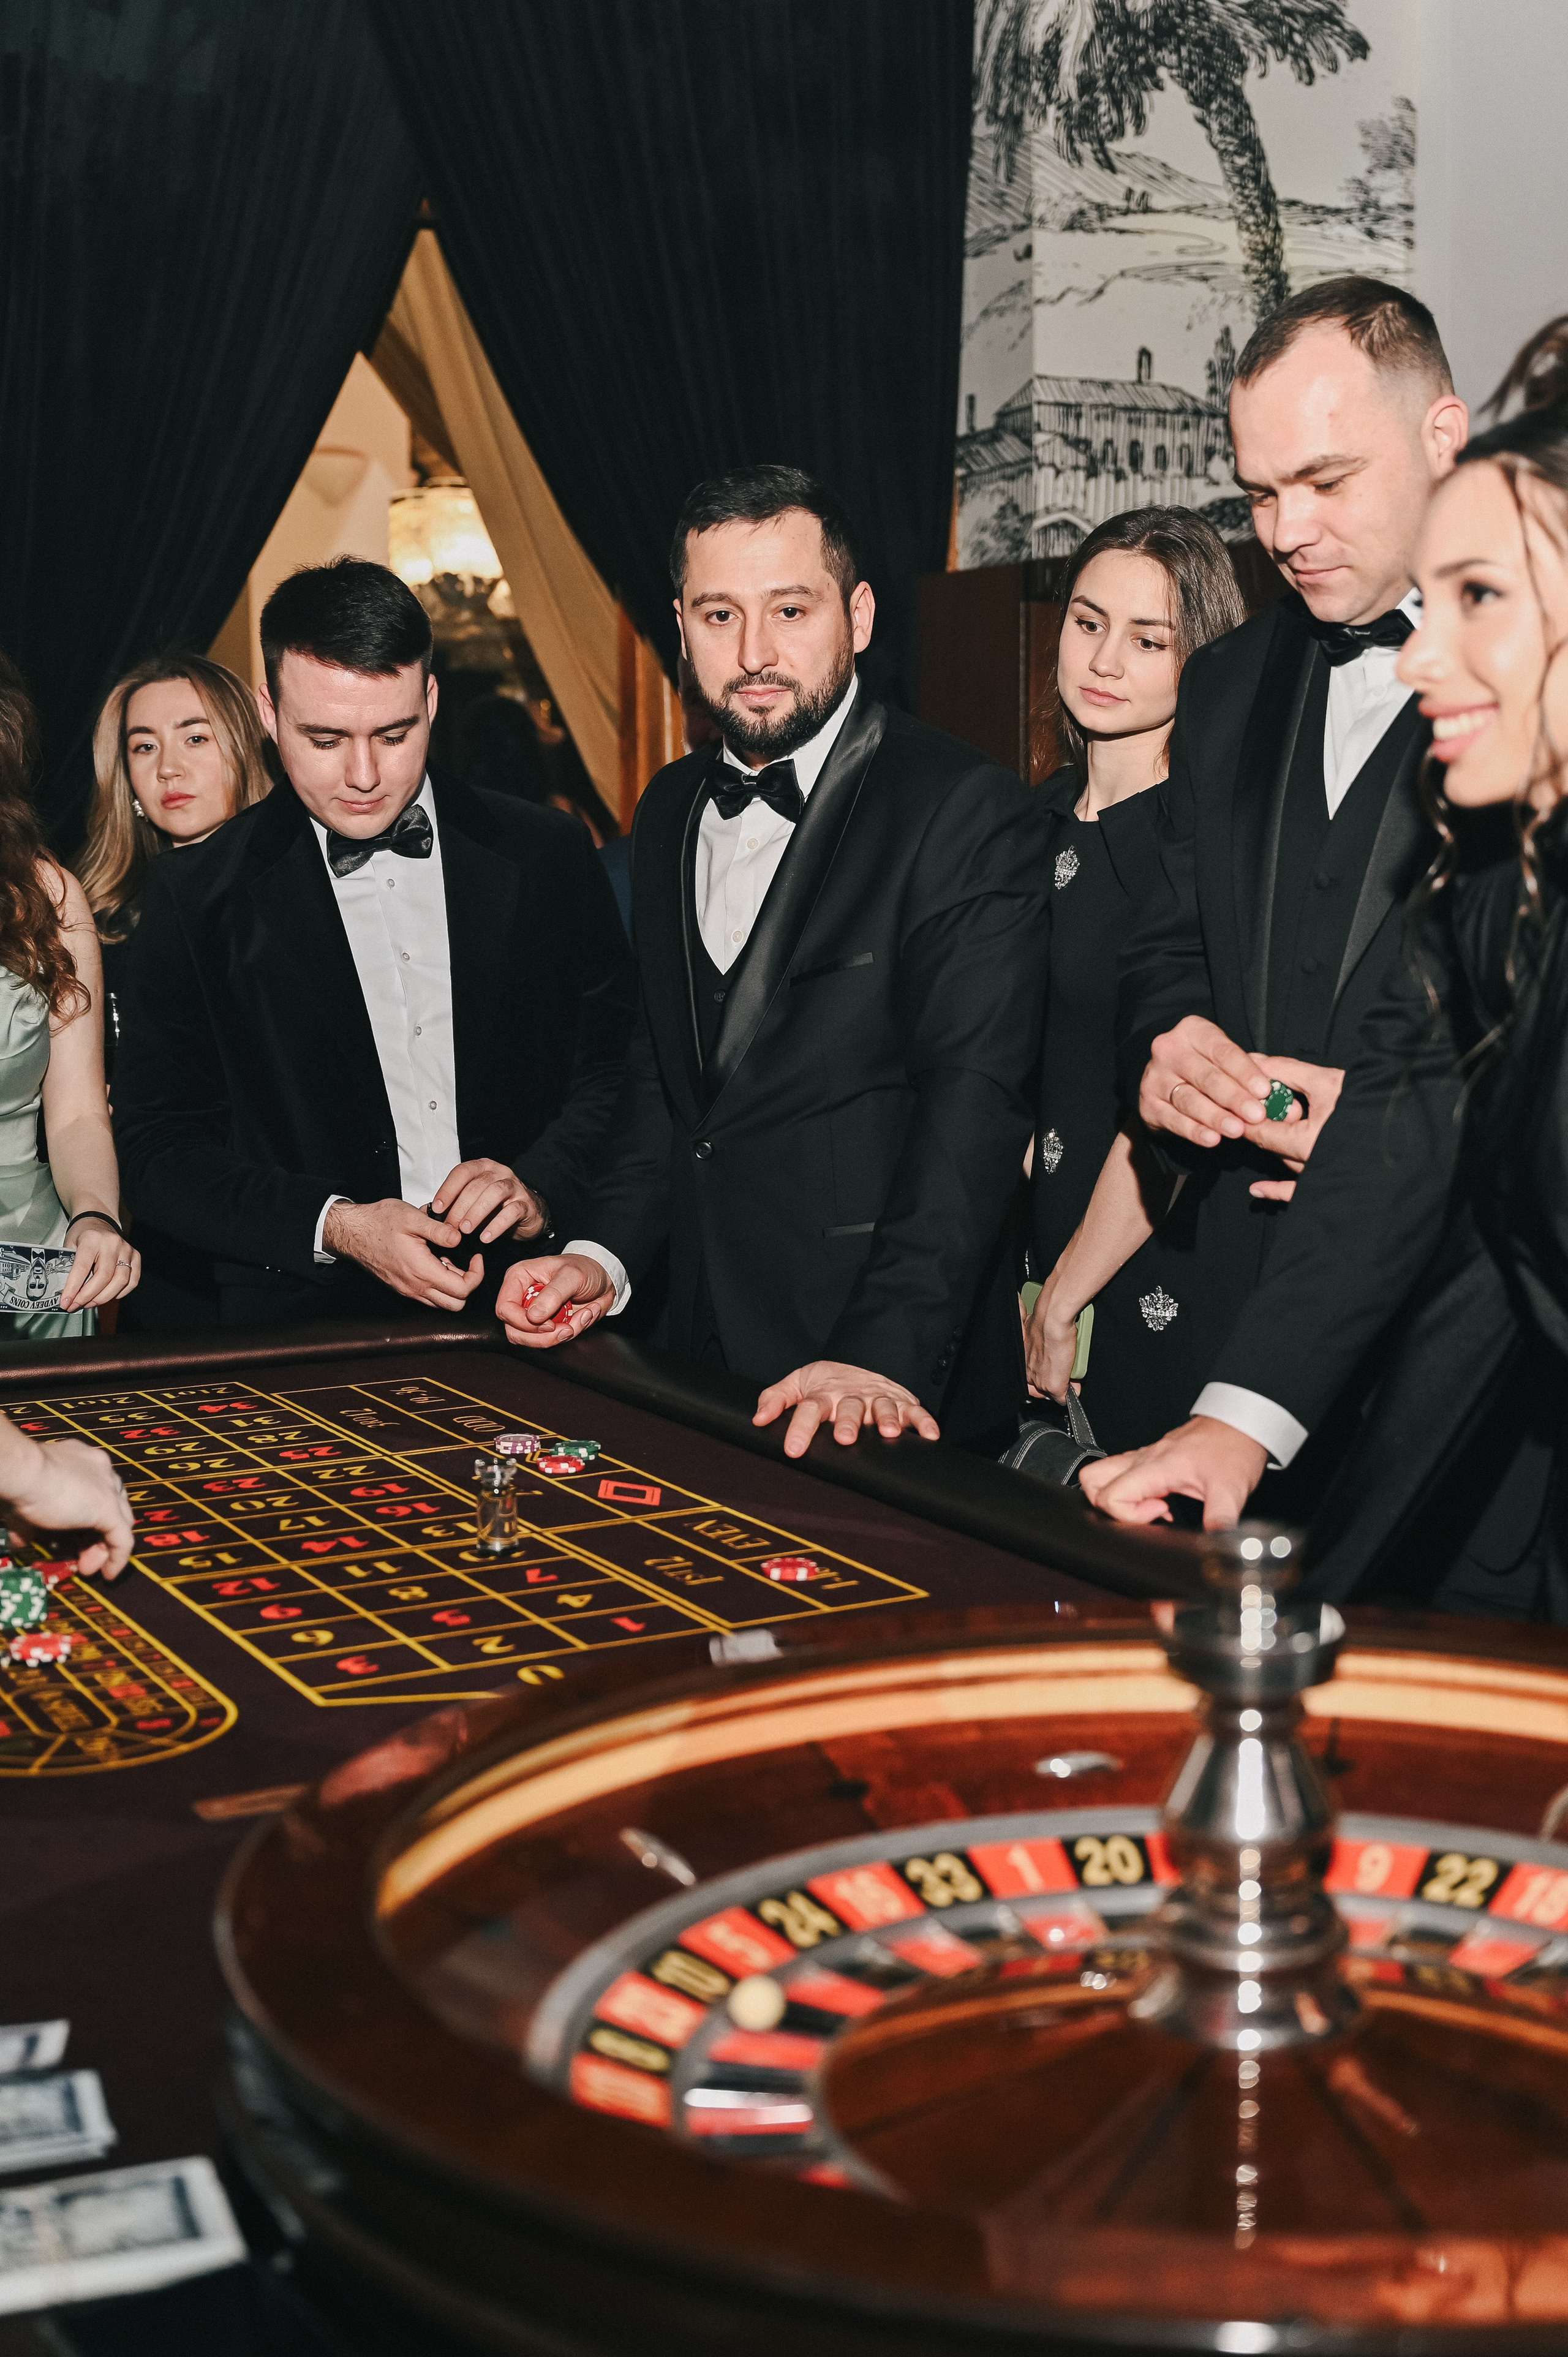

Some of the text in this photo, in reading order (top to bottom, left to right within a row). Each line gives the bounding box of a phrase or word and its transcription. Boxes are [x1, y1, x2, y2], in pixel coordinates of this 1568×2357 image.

[10, 1295, 59, 1309] AVDEEV COINS
[197, 1398, 258, 1412] 34
[99, 1412, 154, 1423] 35
[230, 1417, 279, 1427] 31
[453, 1416, 506, 1432] ODD
[119, 1426, 180, 1439] 32
[247, 1431, 307, 1444] 28
[144, 1442, 206, 1455] 29
[278, 1446, 341, 1460] 25
[168, 1458, 235, 1471] 26
[312, 1465, 375, 1479] 22
[203, 1476, 266, 1492] 23
[350, 1482, 410, 1497] 19
[230, 1495, 299, 1511] 20
[375, 1502, 440, 1517] 16
[279, 1515, 330, 1531] 17
[143, 1529, 209, 1547] 18
[684, 1519, 771, 1549] EVEN
[301, 1536, 369, 1553] 14
[178, 1552, 242, 1569] 15
[343, 1561, 402, 1578] 11
[525, 1567, 558, 1584] 7
[212, 1577, 281, 1596] 12
[388, 1586, 429, 1601] 8
[556, 1593, 593, 1608] 4
[259, 1604, 303, 1620] 9
[290, 1629, 334, 1646] 6
[472, 1635, 516, 1654] 2
[336, 1654, 379, 1675] 3
[1075, 1836, 1144, 1885] 20
[1354, 1842, 1393, 1893] 9
[1422, 1853, 1499, 1907] 22
